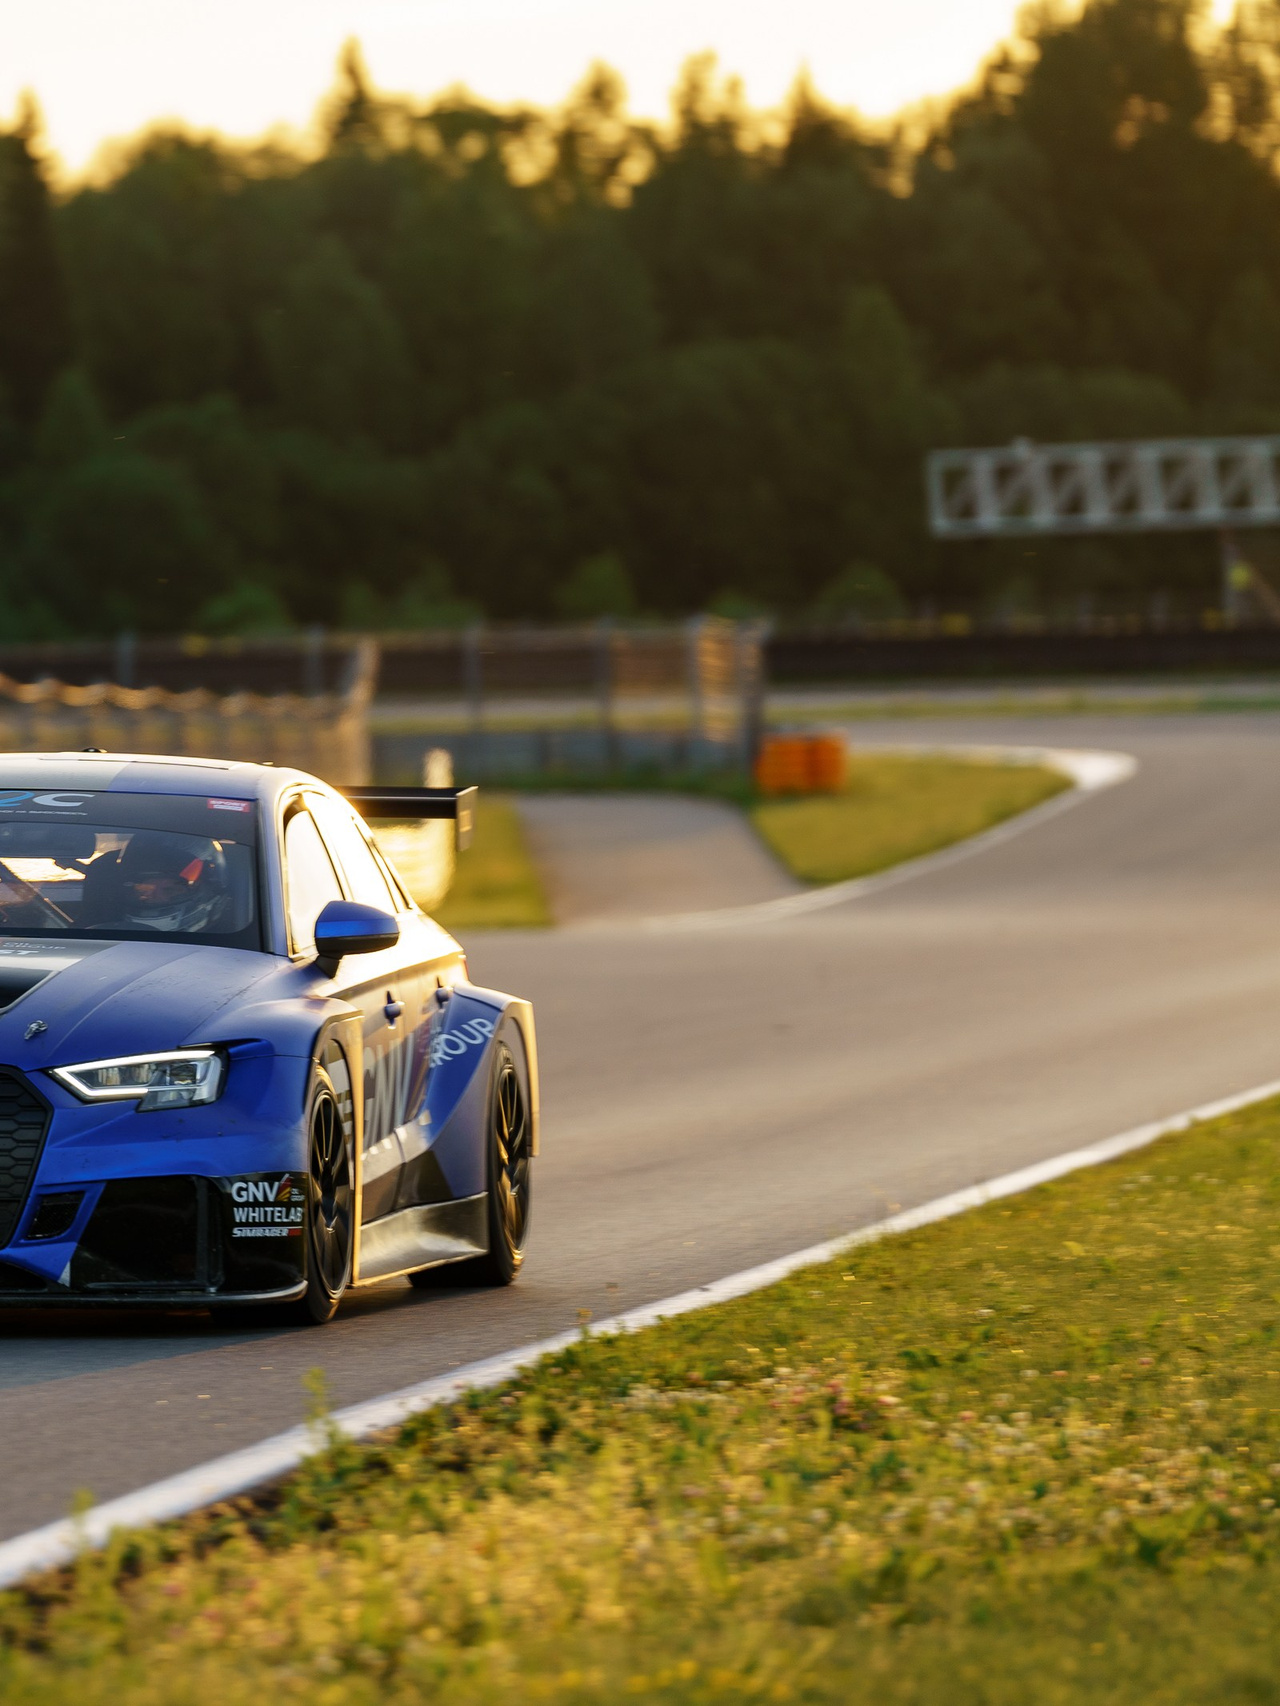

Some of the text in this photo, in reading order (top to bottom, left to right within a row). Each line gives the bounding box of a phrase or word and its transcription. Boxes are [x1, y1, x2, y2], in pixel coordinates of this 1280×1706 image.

[429, 1018, 495, 1068] ROUP
[231, 1181, 280, 1203] GNV
[233, 1207, 304, 1223] WHITELAB
